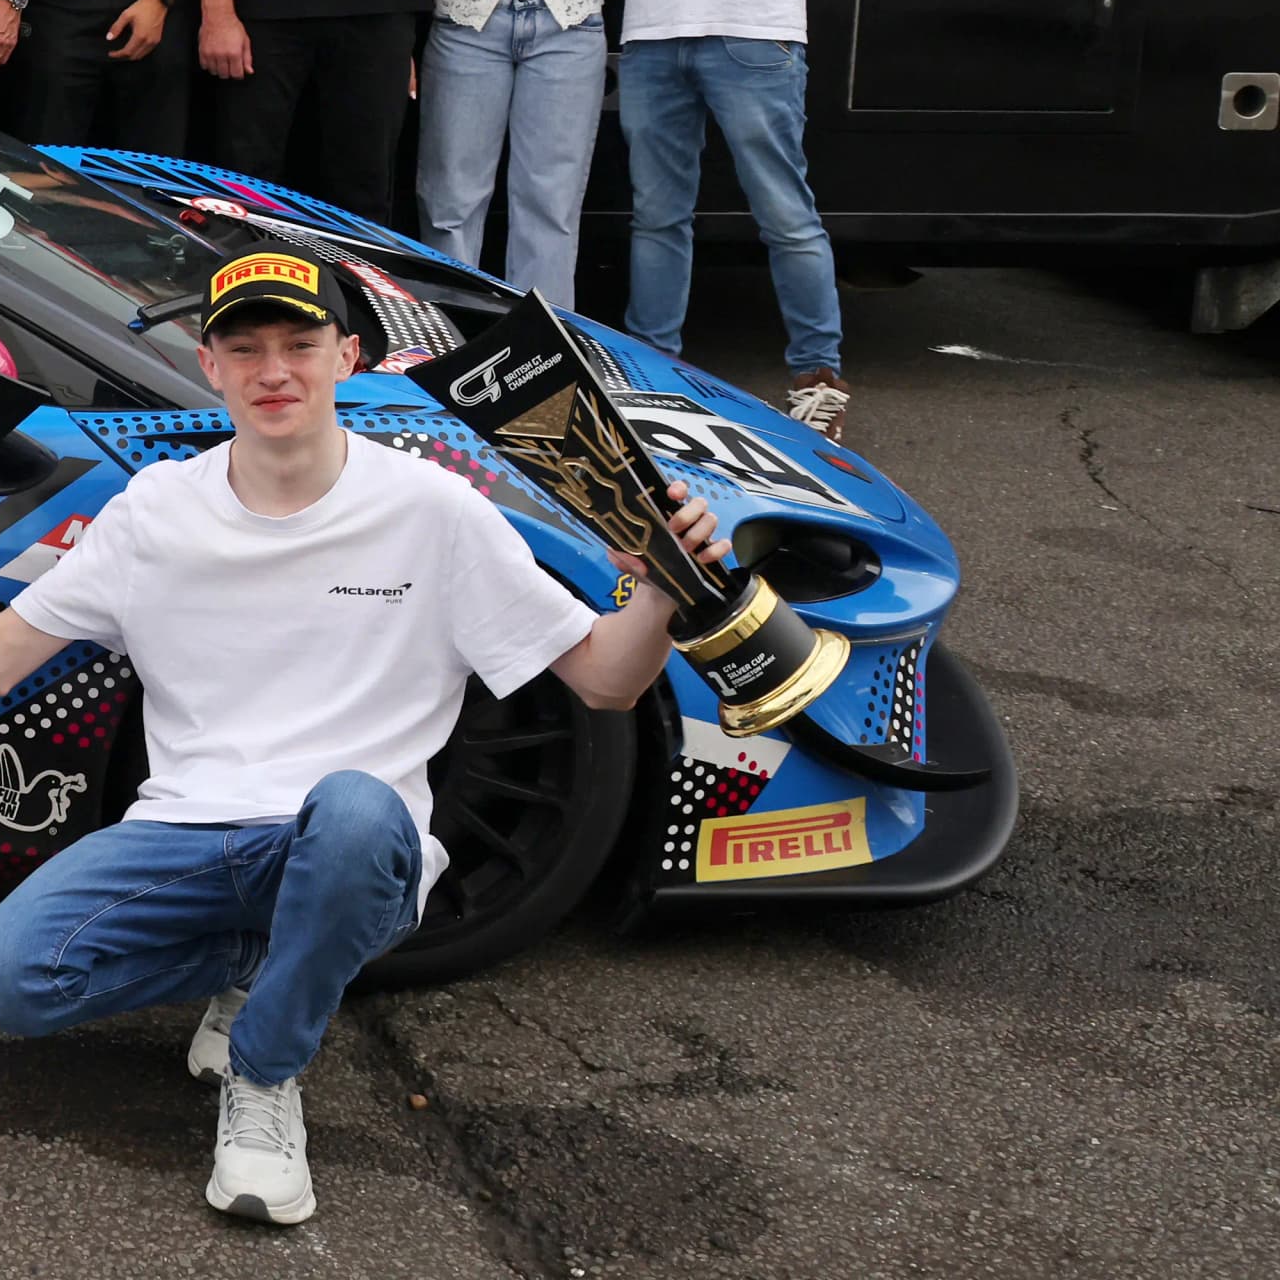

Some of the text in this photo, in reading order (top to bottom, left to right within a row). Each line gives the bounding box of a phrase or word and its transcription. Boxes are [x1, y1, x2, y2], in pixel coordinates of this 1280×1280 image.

[215, 256, 312, 294] PIRELLI
[503, 354, 543, 384] BRITISH GT
[507, 353, 564, 392] CHAMPIONSHIP
[328, 585, 404, 596] McLaren
[722, 662, 737, 673] GT4
[727, 652, 766, 679] SILVER CUP
[706, 671, 738, 697] 1
[709, 811, 853, 867] PIRELLI
